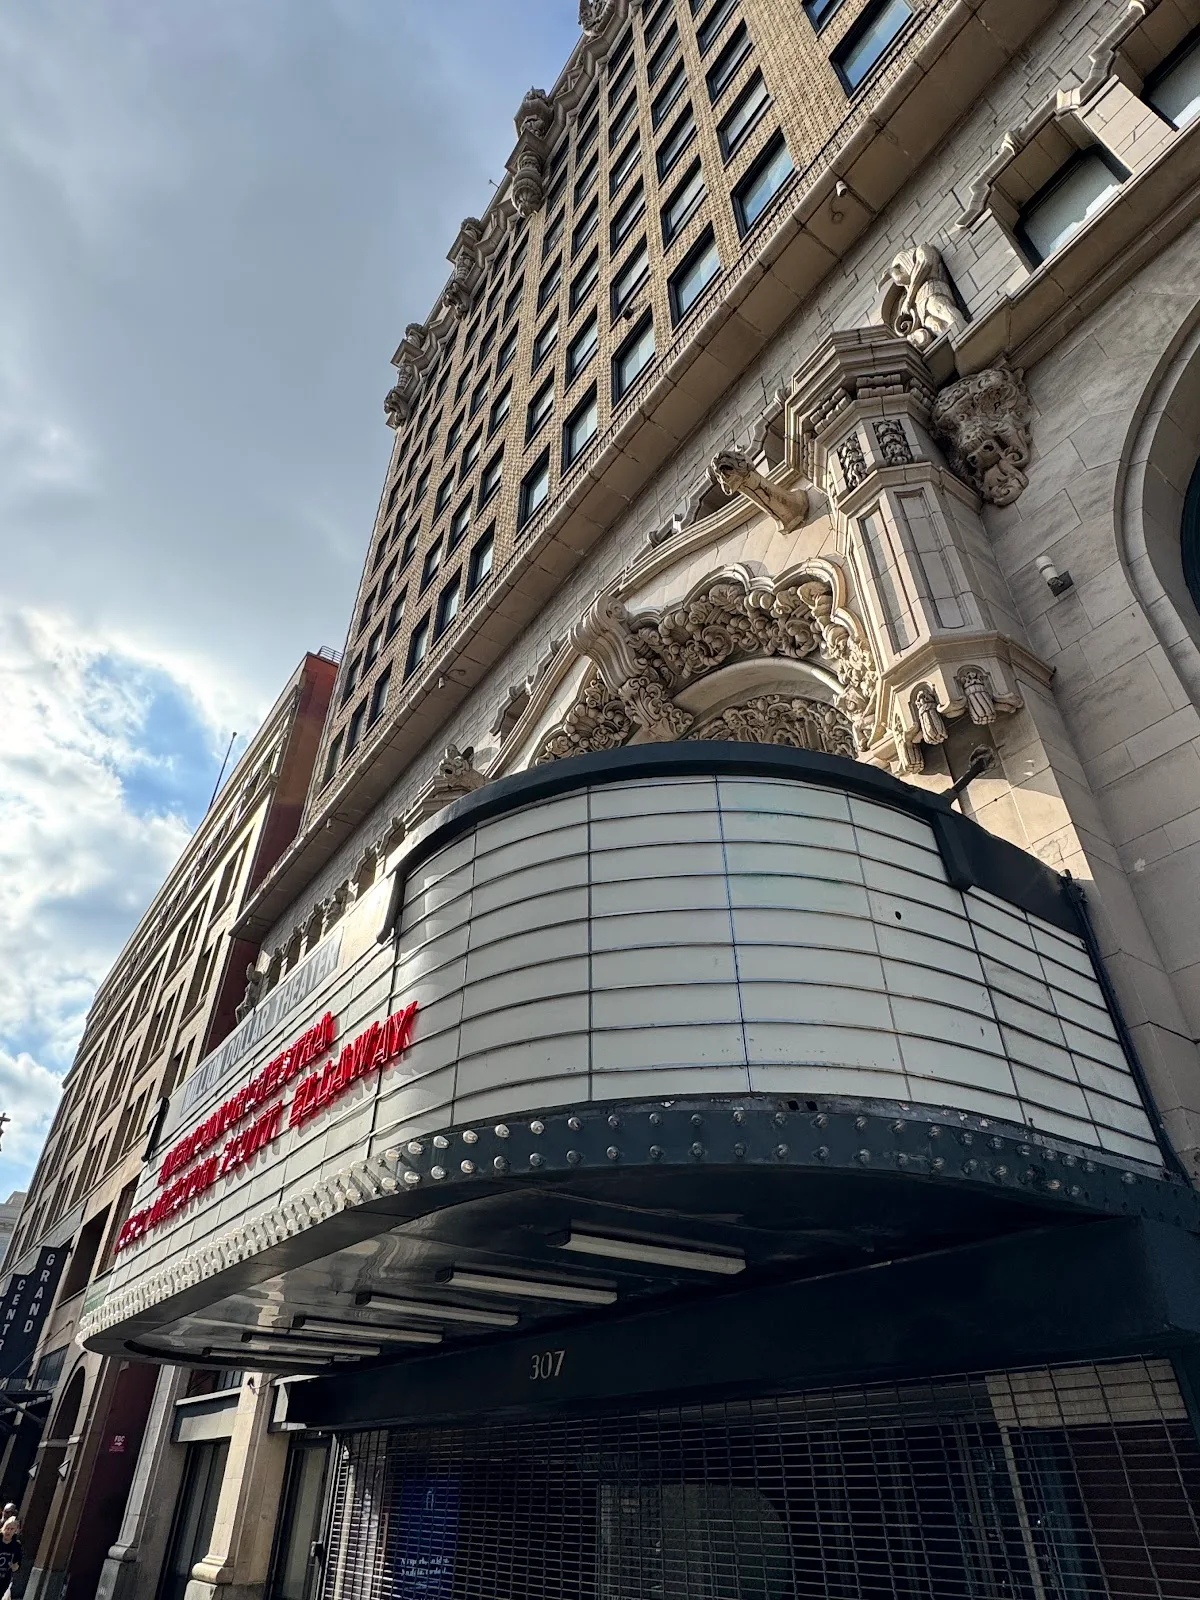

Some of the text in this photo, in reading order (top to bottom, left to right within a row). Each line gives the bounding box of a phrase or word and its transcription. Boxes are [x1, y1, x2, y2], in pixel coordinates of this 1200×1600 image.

[183, 936, 339, 1114] MILLION DOLLAR THEATER
[224, 1011, 335, 1129] ORCHESTRA
[217, 1100, 283, 1177] SCOTT
[289, 1000, 418, 1127] ELLAWAY
[23, 1253, 56, 1333] GRAND
[530, 1350, 566, 1380] 307
